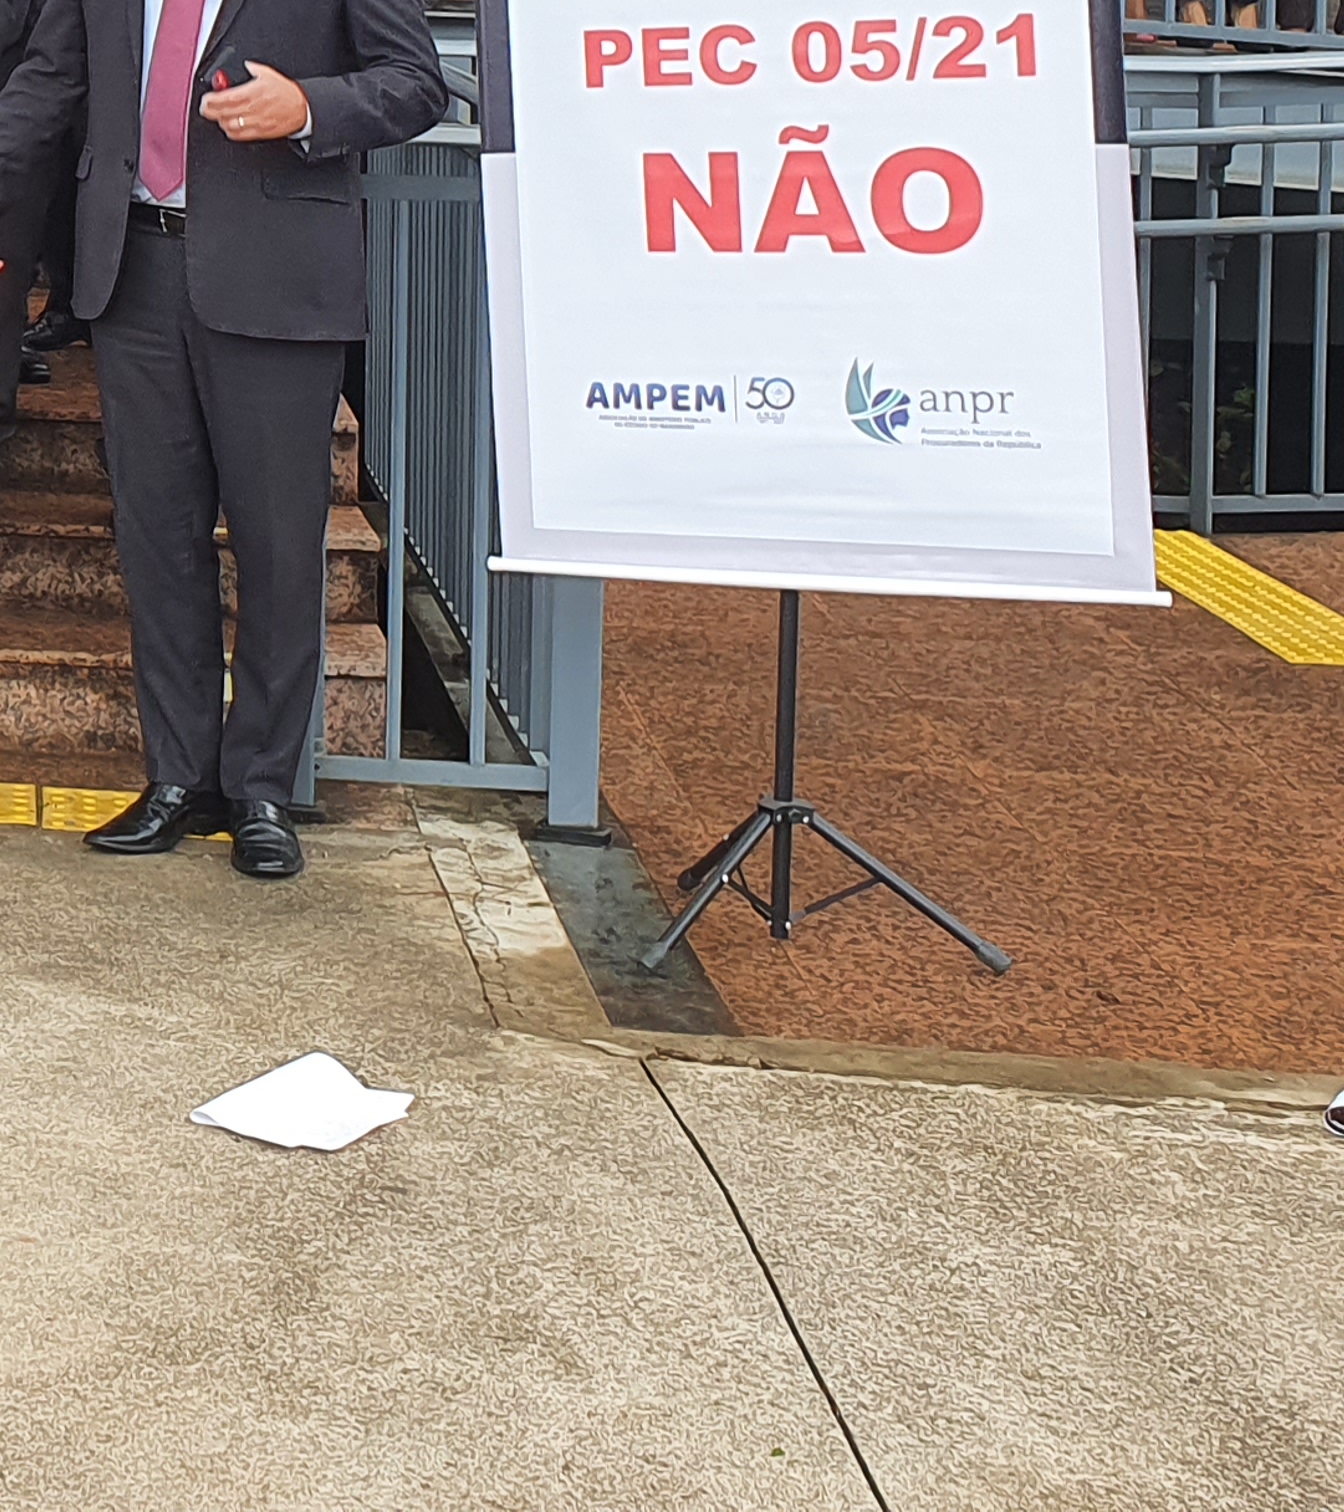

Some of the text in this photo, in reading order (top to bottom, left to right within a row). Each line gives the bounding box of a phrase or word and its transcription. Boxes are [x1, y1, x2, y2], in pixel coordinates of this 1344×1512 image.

[584, 14, 1036, 88] PEC 05/21
[643, 125, 983, 254] NÃO
[586, 382, 726, 413] AMPEM
[745, 377, 795, 410] 50
[920, 390, 1014, 424] anpr
